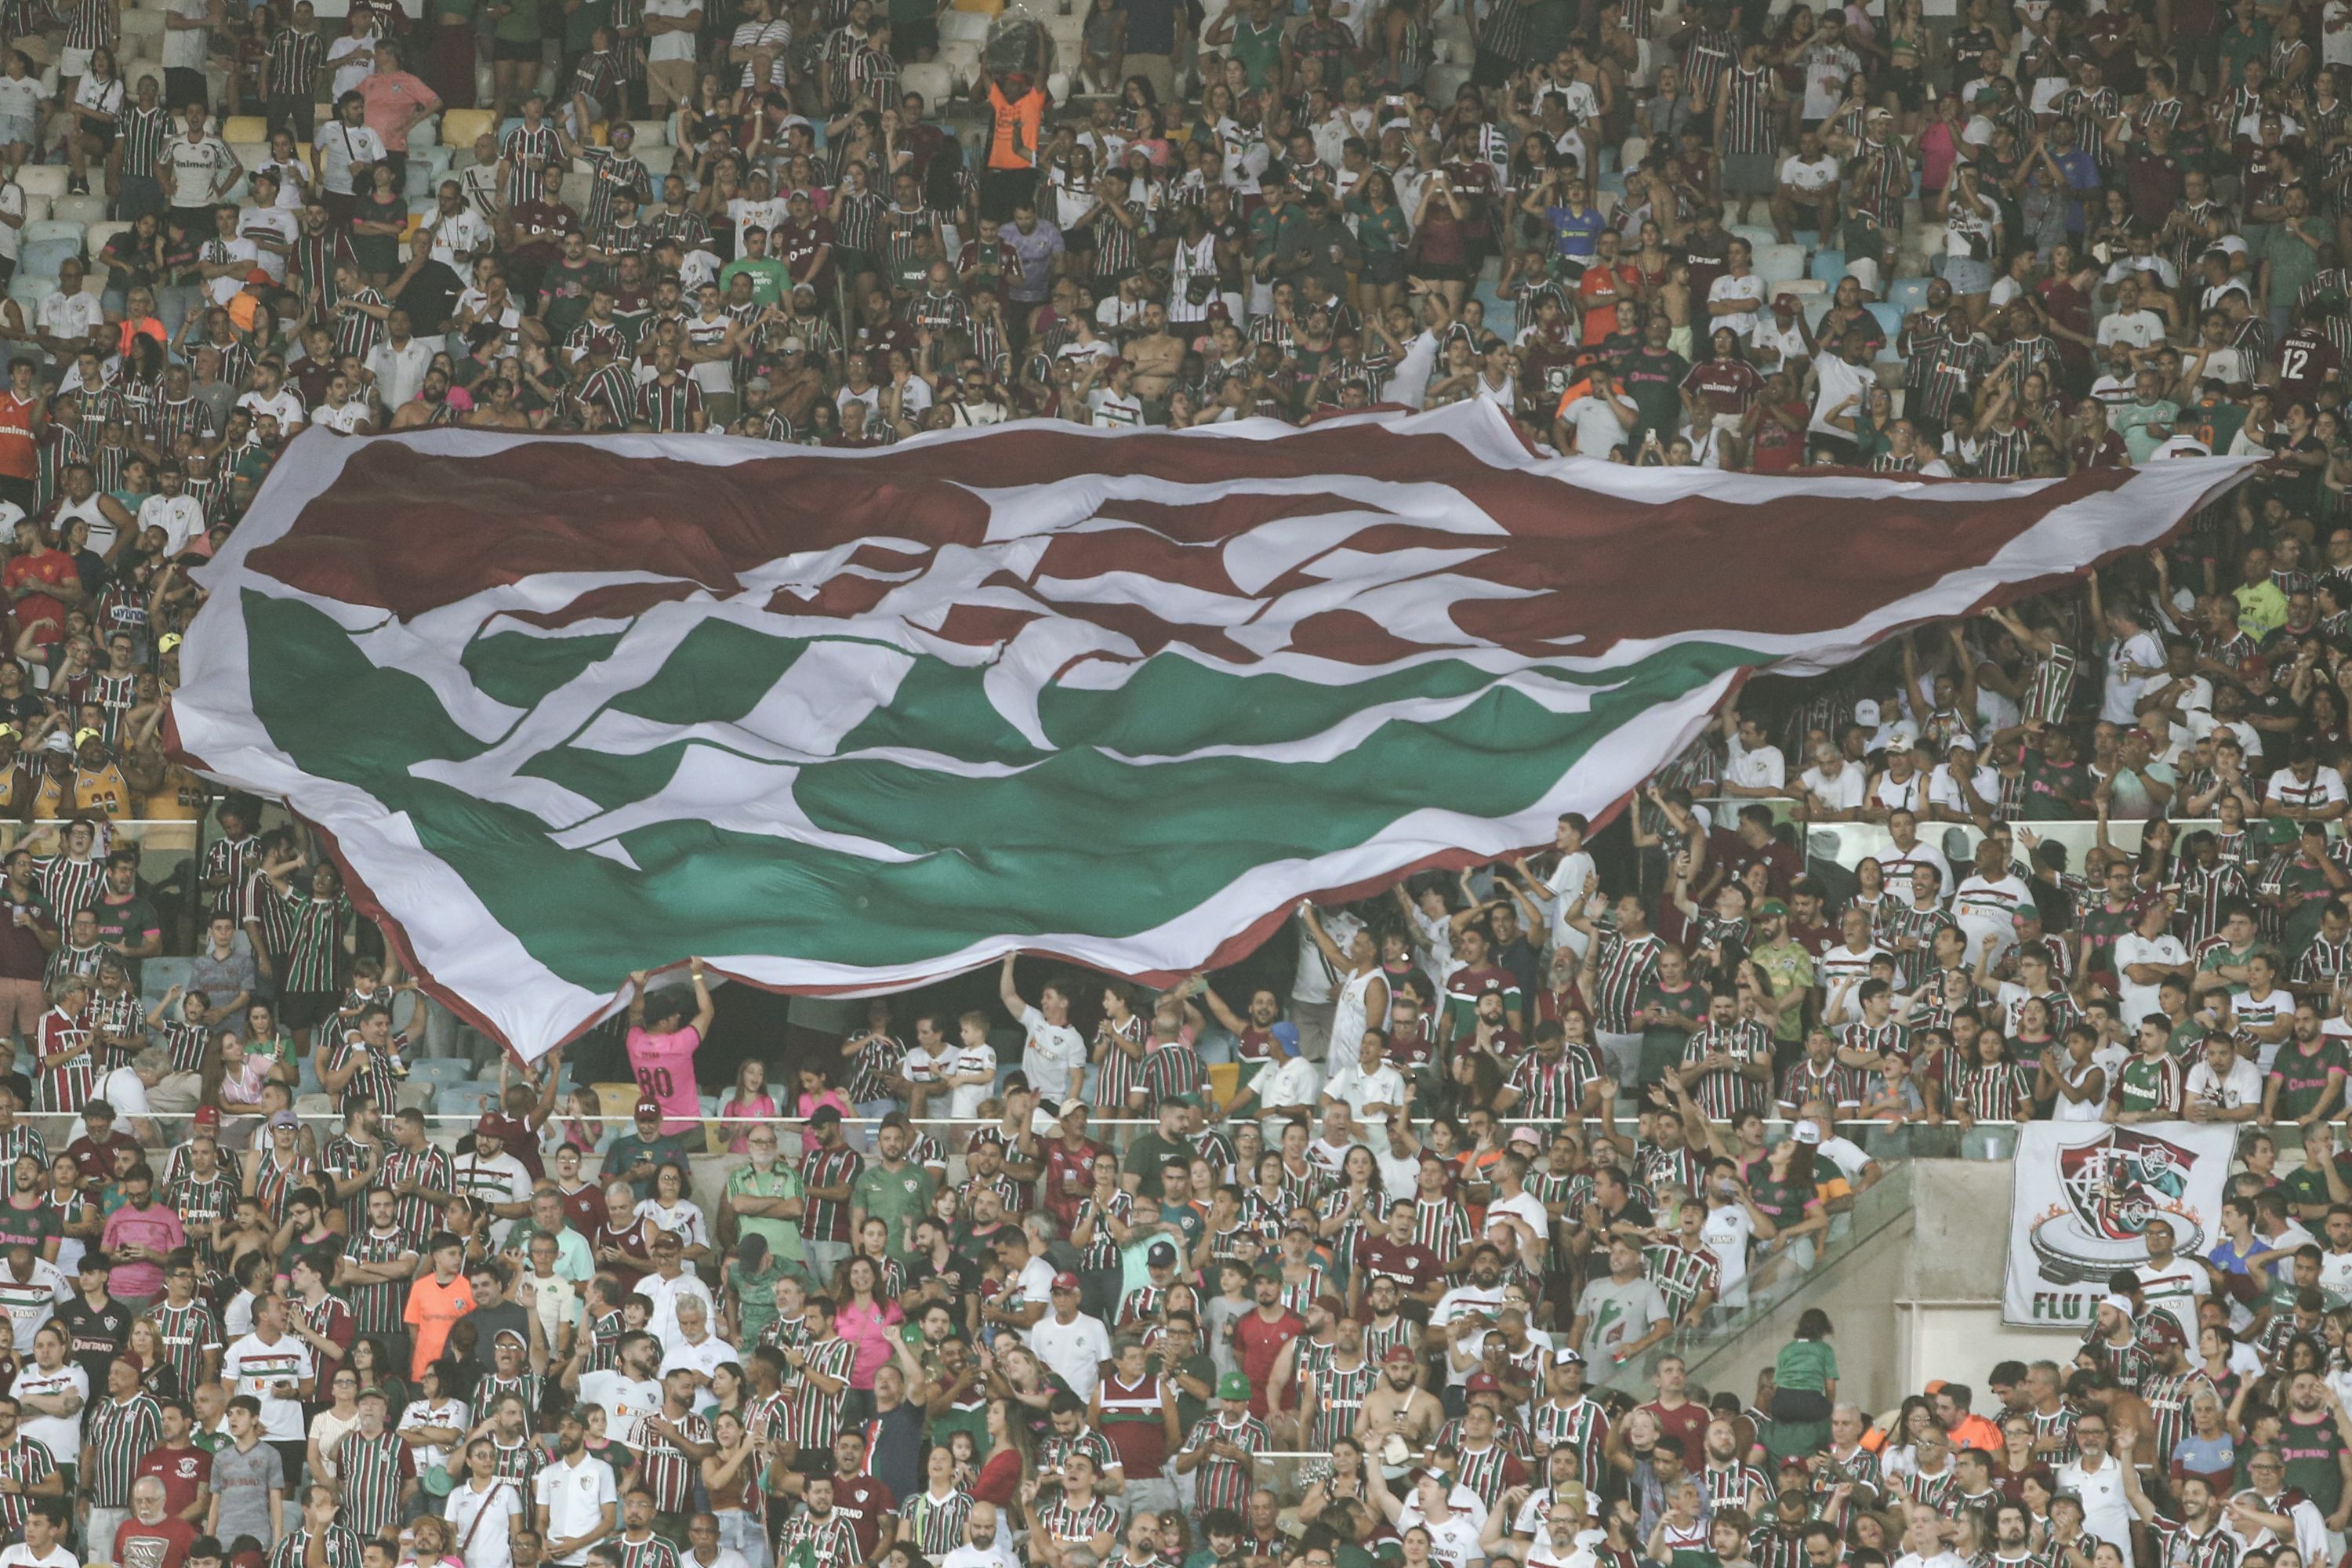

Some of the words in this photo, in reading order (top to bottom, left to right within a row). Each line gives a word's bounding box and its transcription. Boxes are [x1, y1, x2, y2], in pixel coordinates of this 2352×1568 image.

[2285, 339, 2317, 350] MARCELO
[2281, 349, 2309, 380] 12
[638, 1066, 676, 1098] 80
[639, 1104, 656, 1112] FFC
[188, 1210, 221, 1219] BETANO
[5, 1233, 38, 1245] BETANO
[2034, 1292, 2081, 1319] FLU
[162, 1336, 194, 1345] BETANO
[81, 1341, 114, 1352] BETANO
[2151, 1399, 2183, 1410] BETANO
[2292, 1449, 2329, 1459] BETANO
[492, 1474, 524, 1486] BETANO
[1710, 1495, 1744, 1508] BETANO
